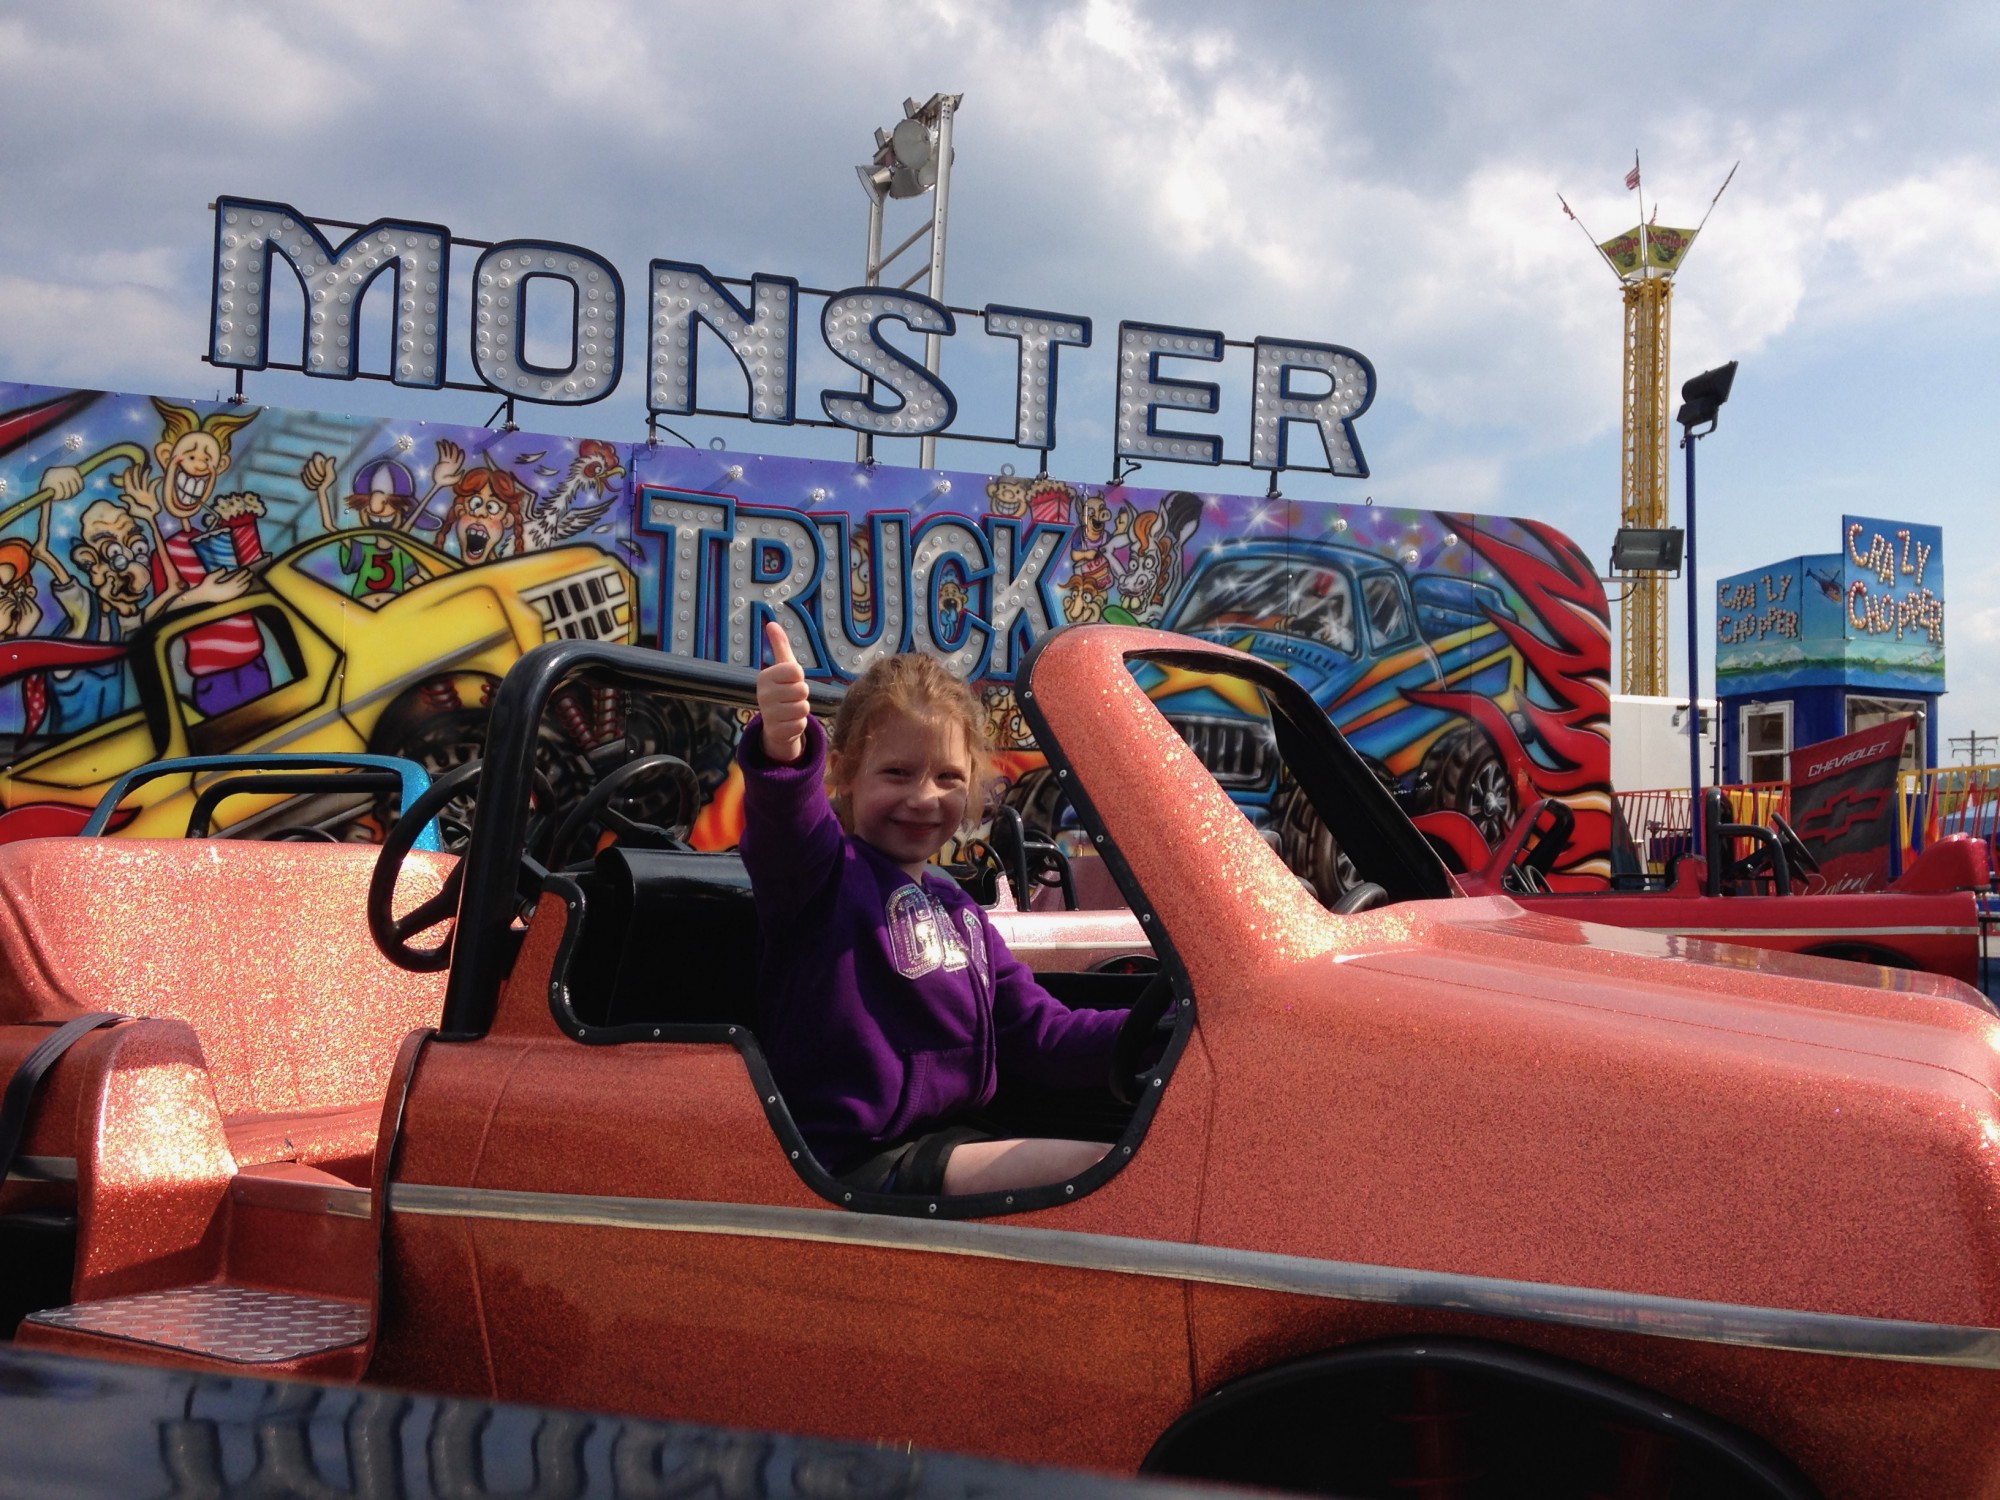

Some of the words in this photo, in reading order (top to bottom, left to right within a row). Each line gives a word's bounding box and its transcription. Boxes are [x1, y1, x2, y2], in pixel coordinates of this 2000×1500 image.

[210, 195, 1377, 478] MONSTER
[366, 553, 395, 590] 5
[1848, 523, 1931, 587] CRAZY
[637, 484, 1075, 684] TRUCK
[1719, 574, 1792, 611] CRAZY
[1717, 607, 1798, 643] CHOPPER
[1849, 581, 1944, 643] CHOPPER
[1808, 741, 1890, 777] CHEVROLET
